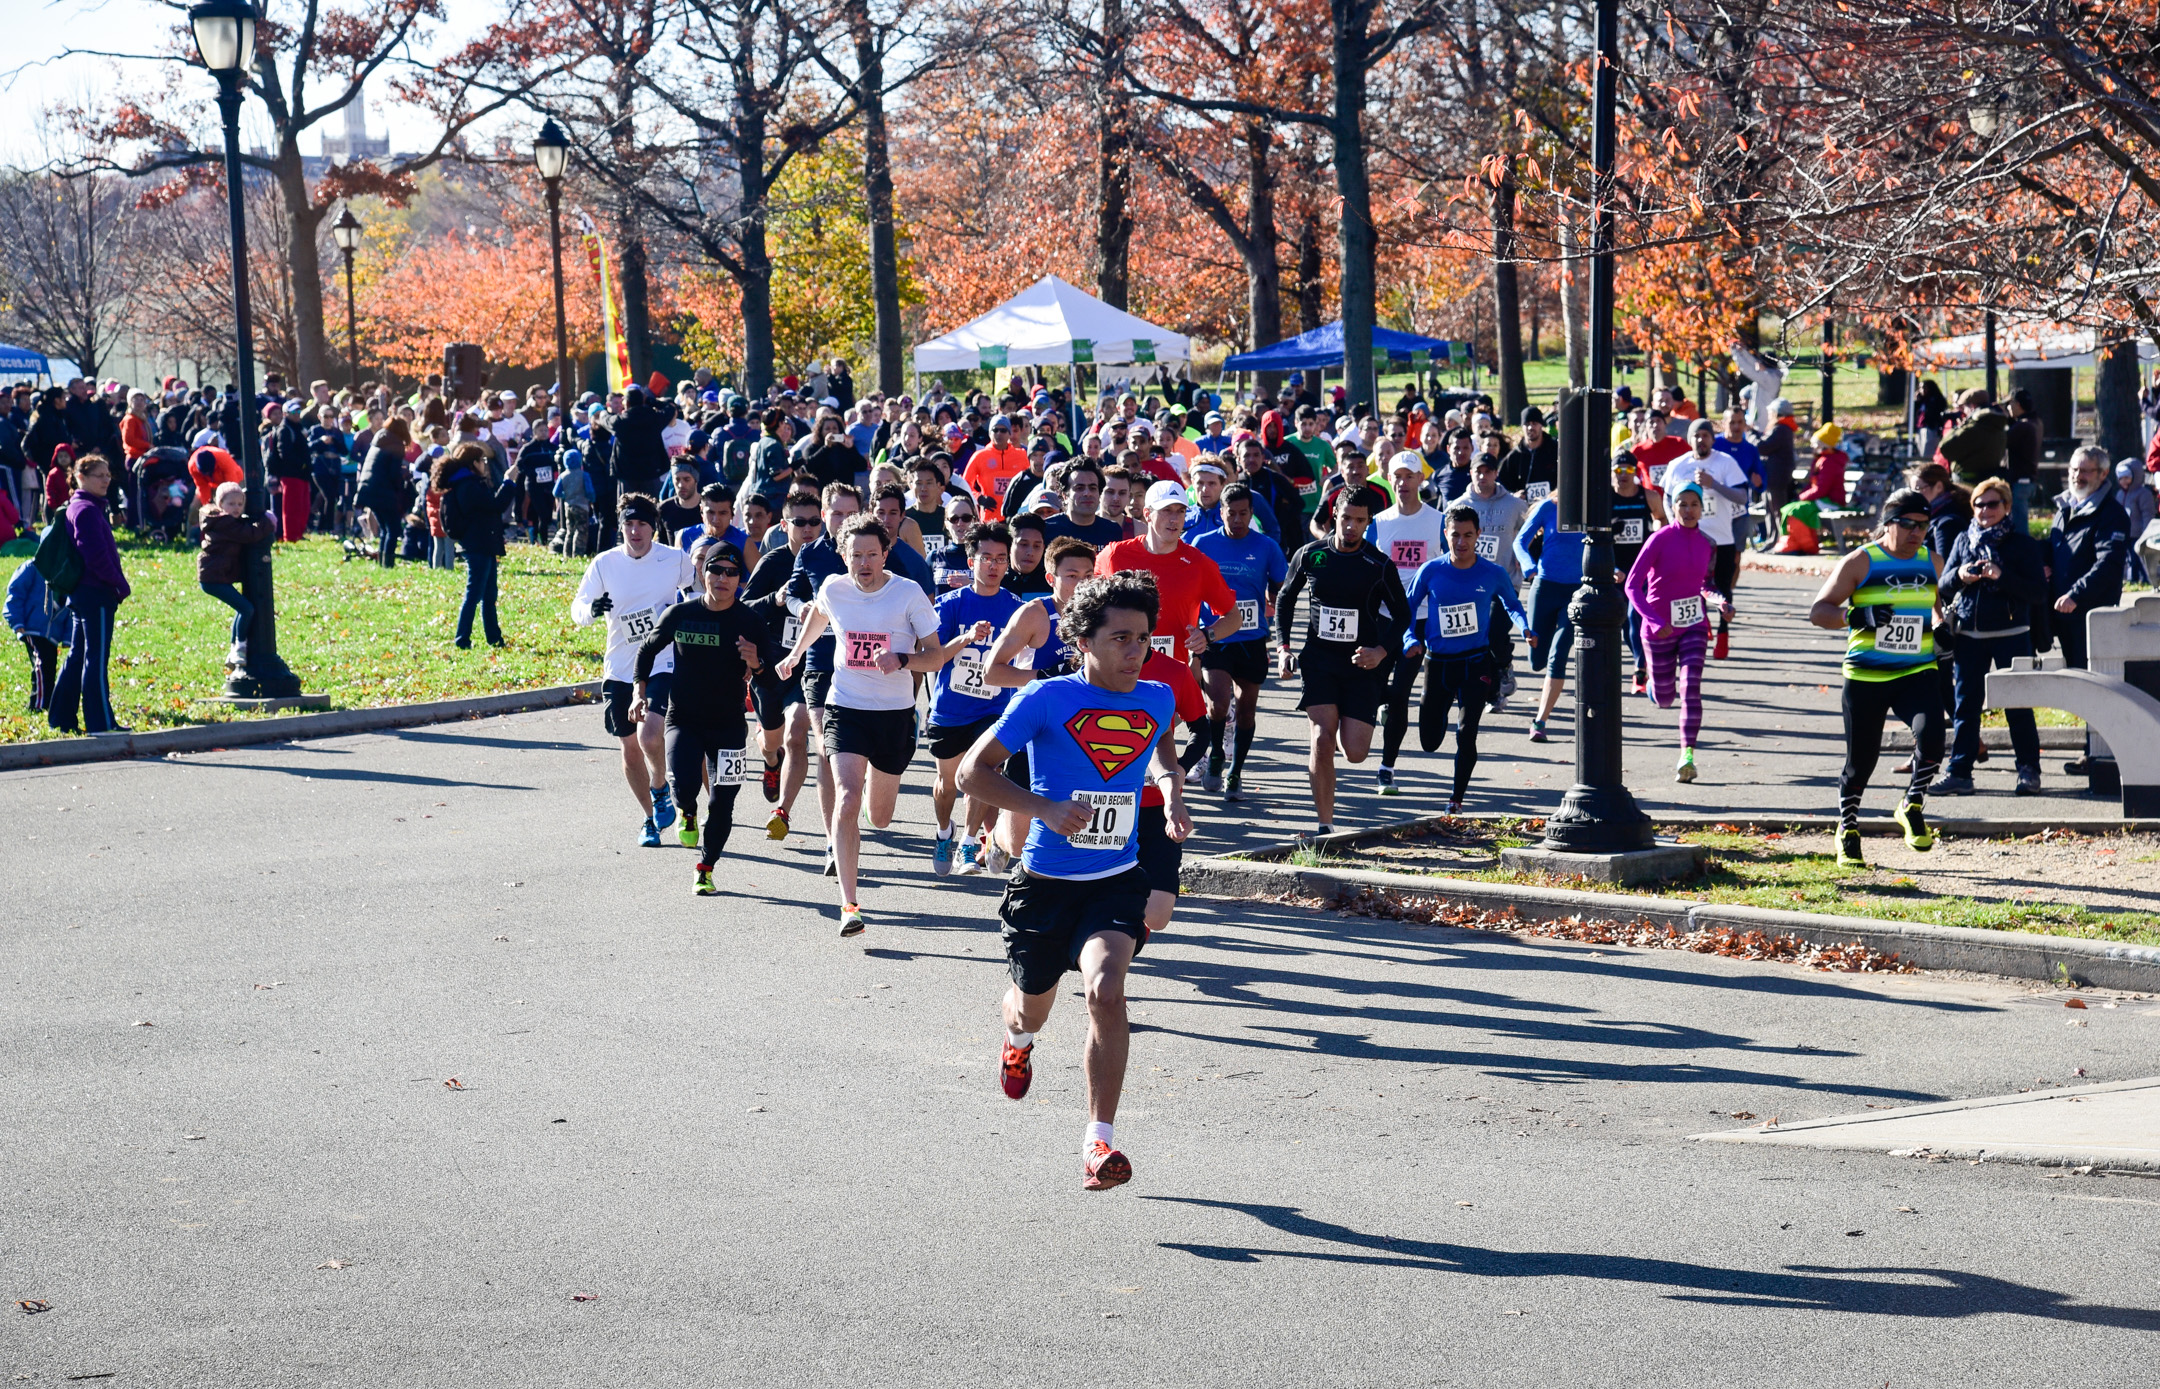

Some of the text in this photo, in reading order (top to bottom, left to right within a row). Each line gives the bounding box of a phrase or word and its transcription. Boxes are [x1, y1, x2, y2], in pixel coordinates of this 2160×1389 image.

[1530, 488, 1546, 498] 260
[1620, 526, 1638, 538] 89
[1398, 548, 1420, 561] 745
[1475, 542, 1493, 554] 276
[621, 614, 629, 622] RUN
[637, 608, 653, 618] BECOME
[1678, 604, 1696, 620] 353
[628, 616, 654, 636] 155
[1329, 616, 1345, 632] 54
[1446, 612, 1470, 629] 311
[628, 635, 643, 643] BECOME
[676, 631, 716, 645] PW3R
[1884, 624, 1914, 642] 290
[1879, 641, 1897, 650] BECOME
[954, 683, 971, 693] BECOME
[1078, 794, 1132, 806] RUN AND BECOME
[1088, 807, 1117, 833] 10
[1070, 834, 1128, 846] BECOME AND RUN
